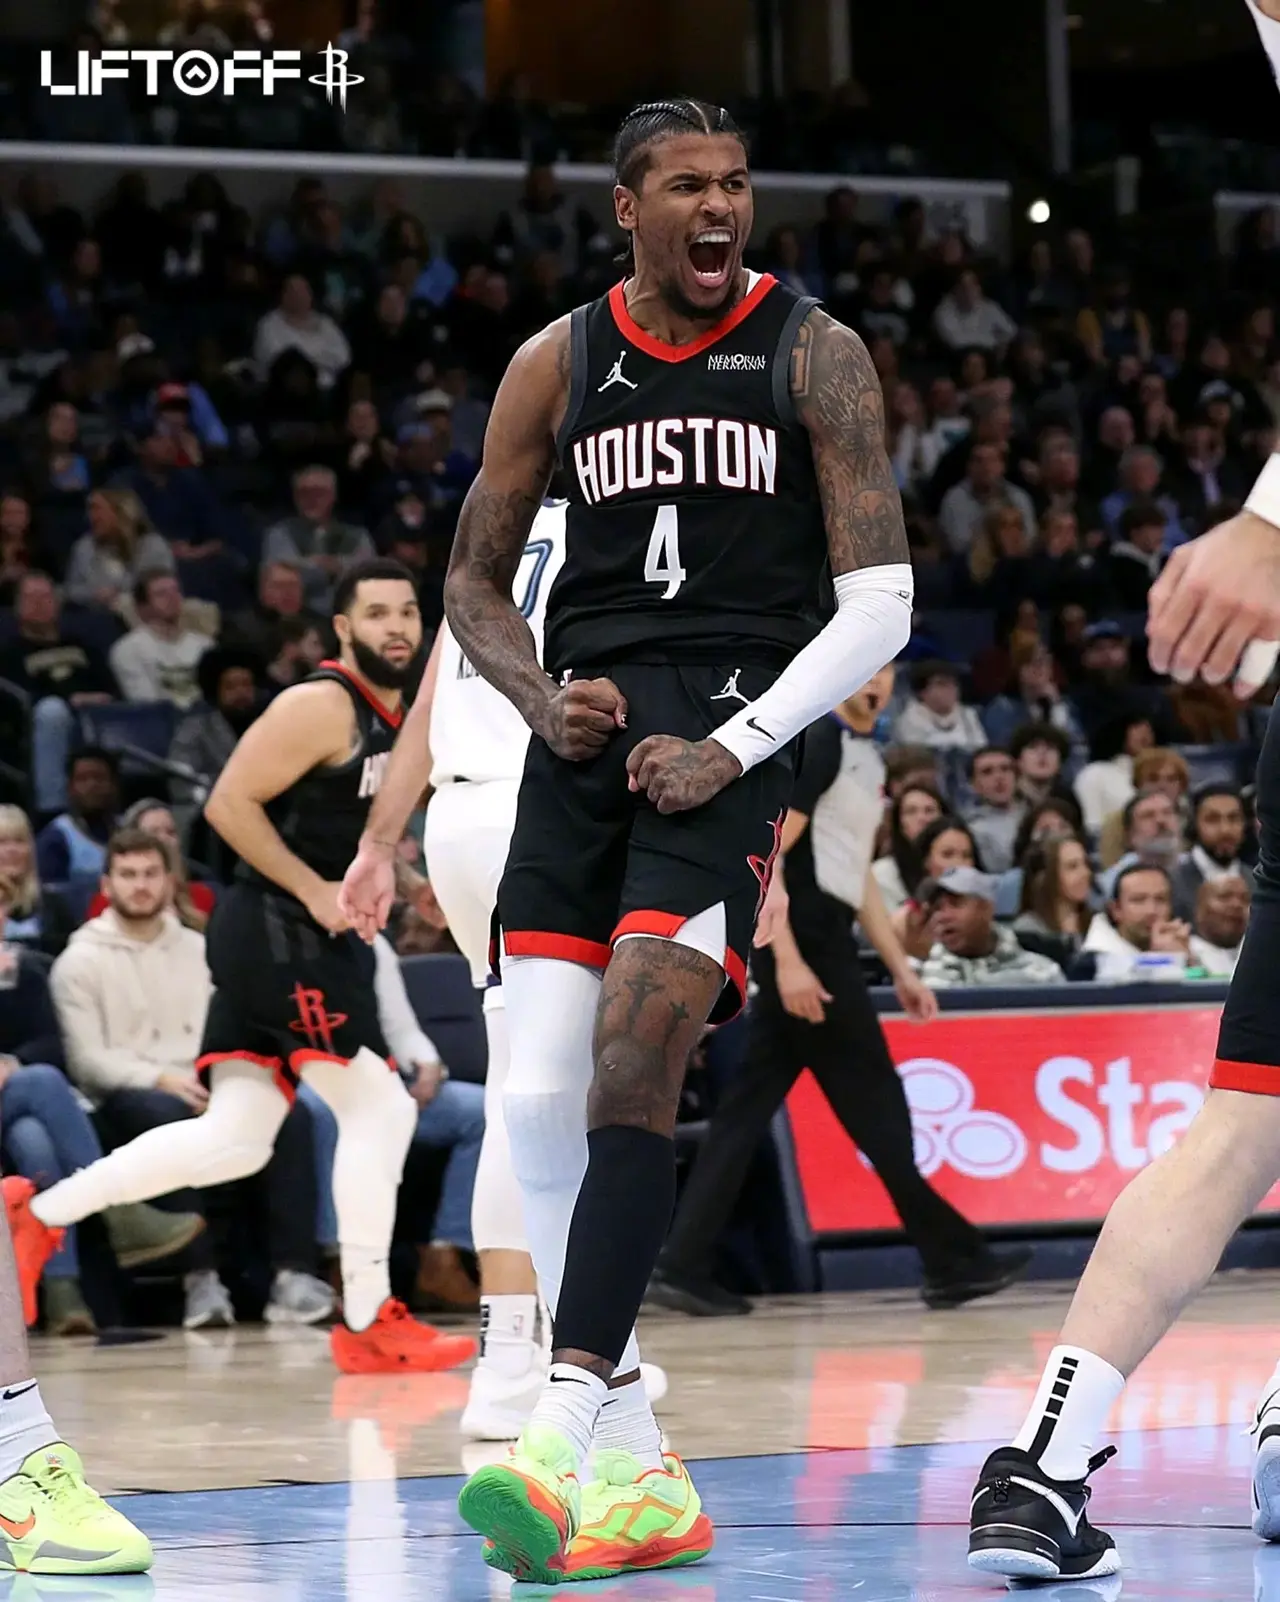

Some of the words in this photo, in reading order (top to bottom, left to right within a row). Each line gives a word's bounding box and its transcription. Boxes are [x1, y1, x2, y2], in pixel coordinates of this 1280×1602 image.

[707, 361, 766, 371] HERMANN
[573, 418, 777, 505] HOUSTON
[522, 538, 554, 619] 7
[644, 504, 686, 600] 4
